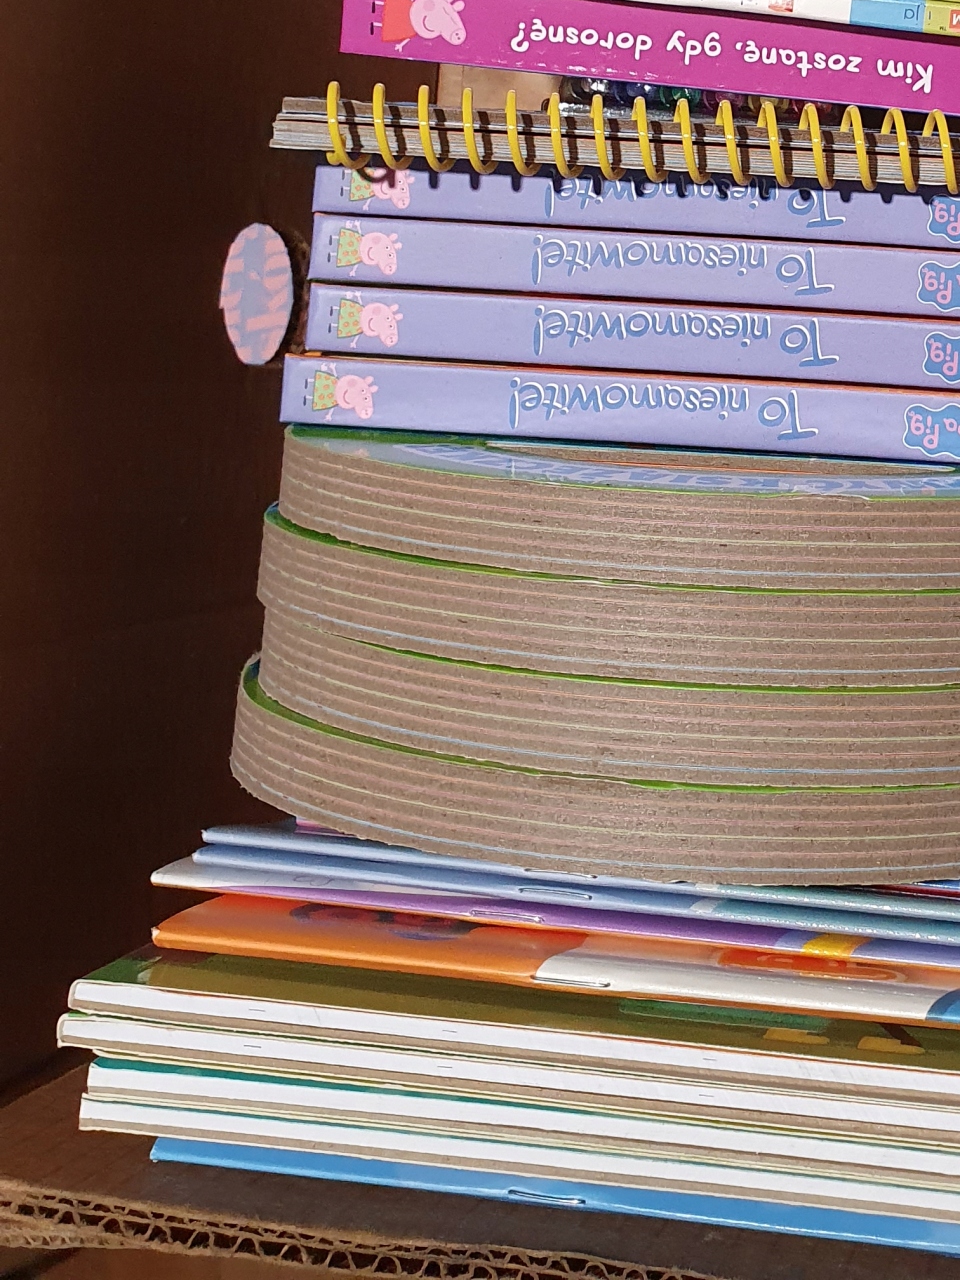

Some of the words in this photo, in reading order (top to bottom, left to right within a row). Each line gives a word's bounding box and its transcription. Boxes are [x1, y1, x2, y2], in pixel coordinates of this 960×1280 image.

[904, 5, 924, 25] ja
[510, 17, 653, 61] dorosnę?
[665, 31, 722, 63] gdy
[735, 39, 863, 77] zostanę,
[876, 58, 934, 94] Kim
[787, 187, 846, 229] To
[530, 233, 767, 285] niesamowite!
[775, 246, 835, 296] To
[923, 267, 952, 303] Pig
[531, 304, 771, 356] niesamowite!
[779, 318, 839, 368] To
[928, 338, 957, 376] Pig
[507, 377, 750, 430] niesamowite!
[757, 391, 819, 441] To
[909, 411, 940, 449] Pig
